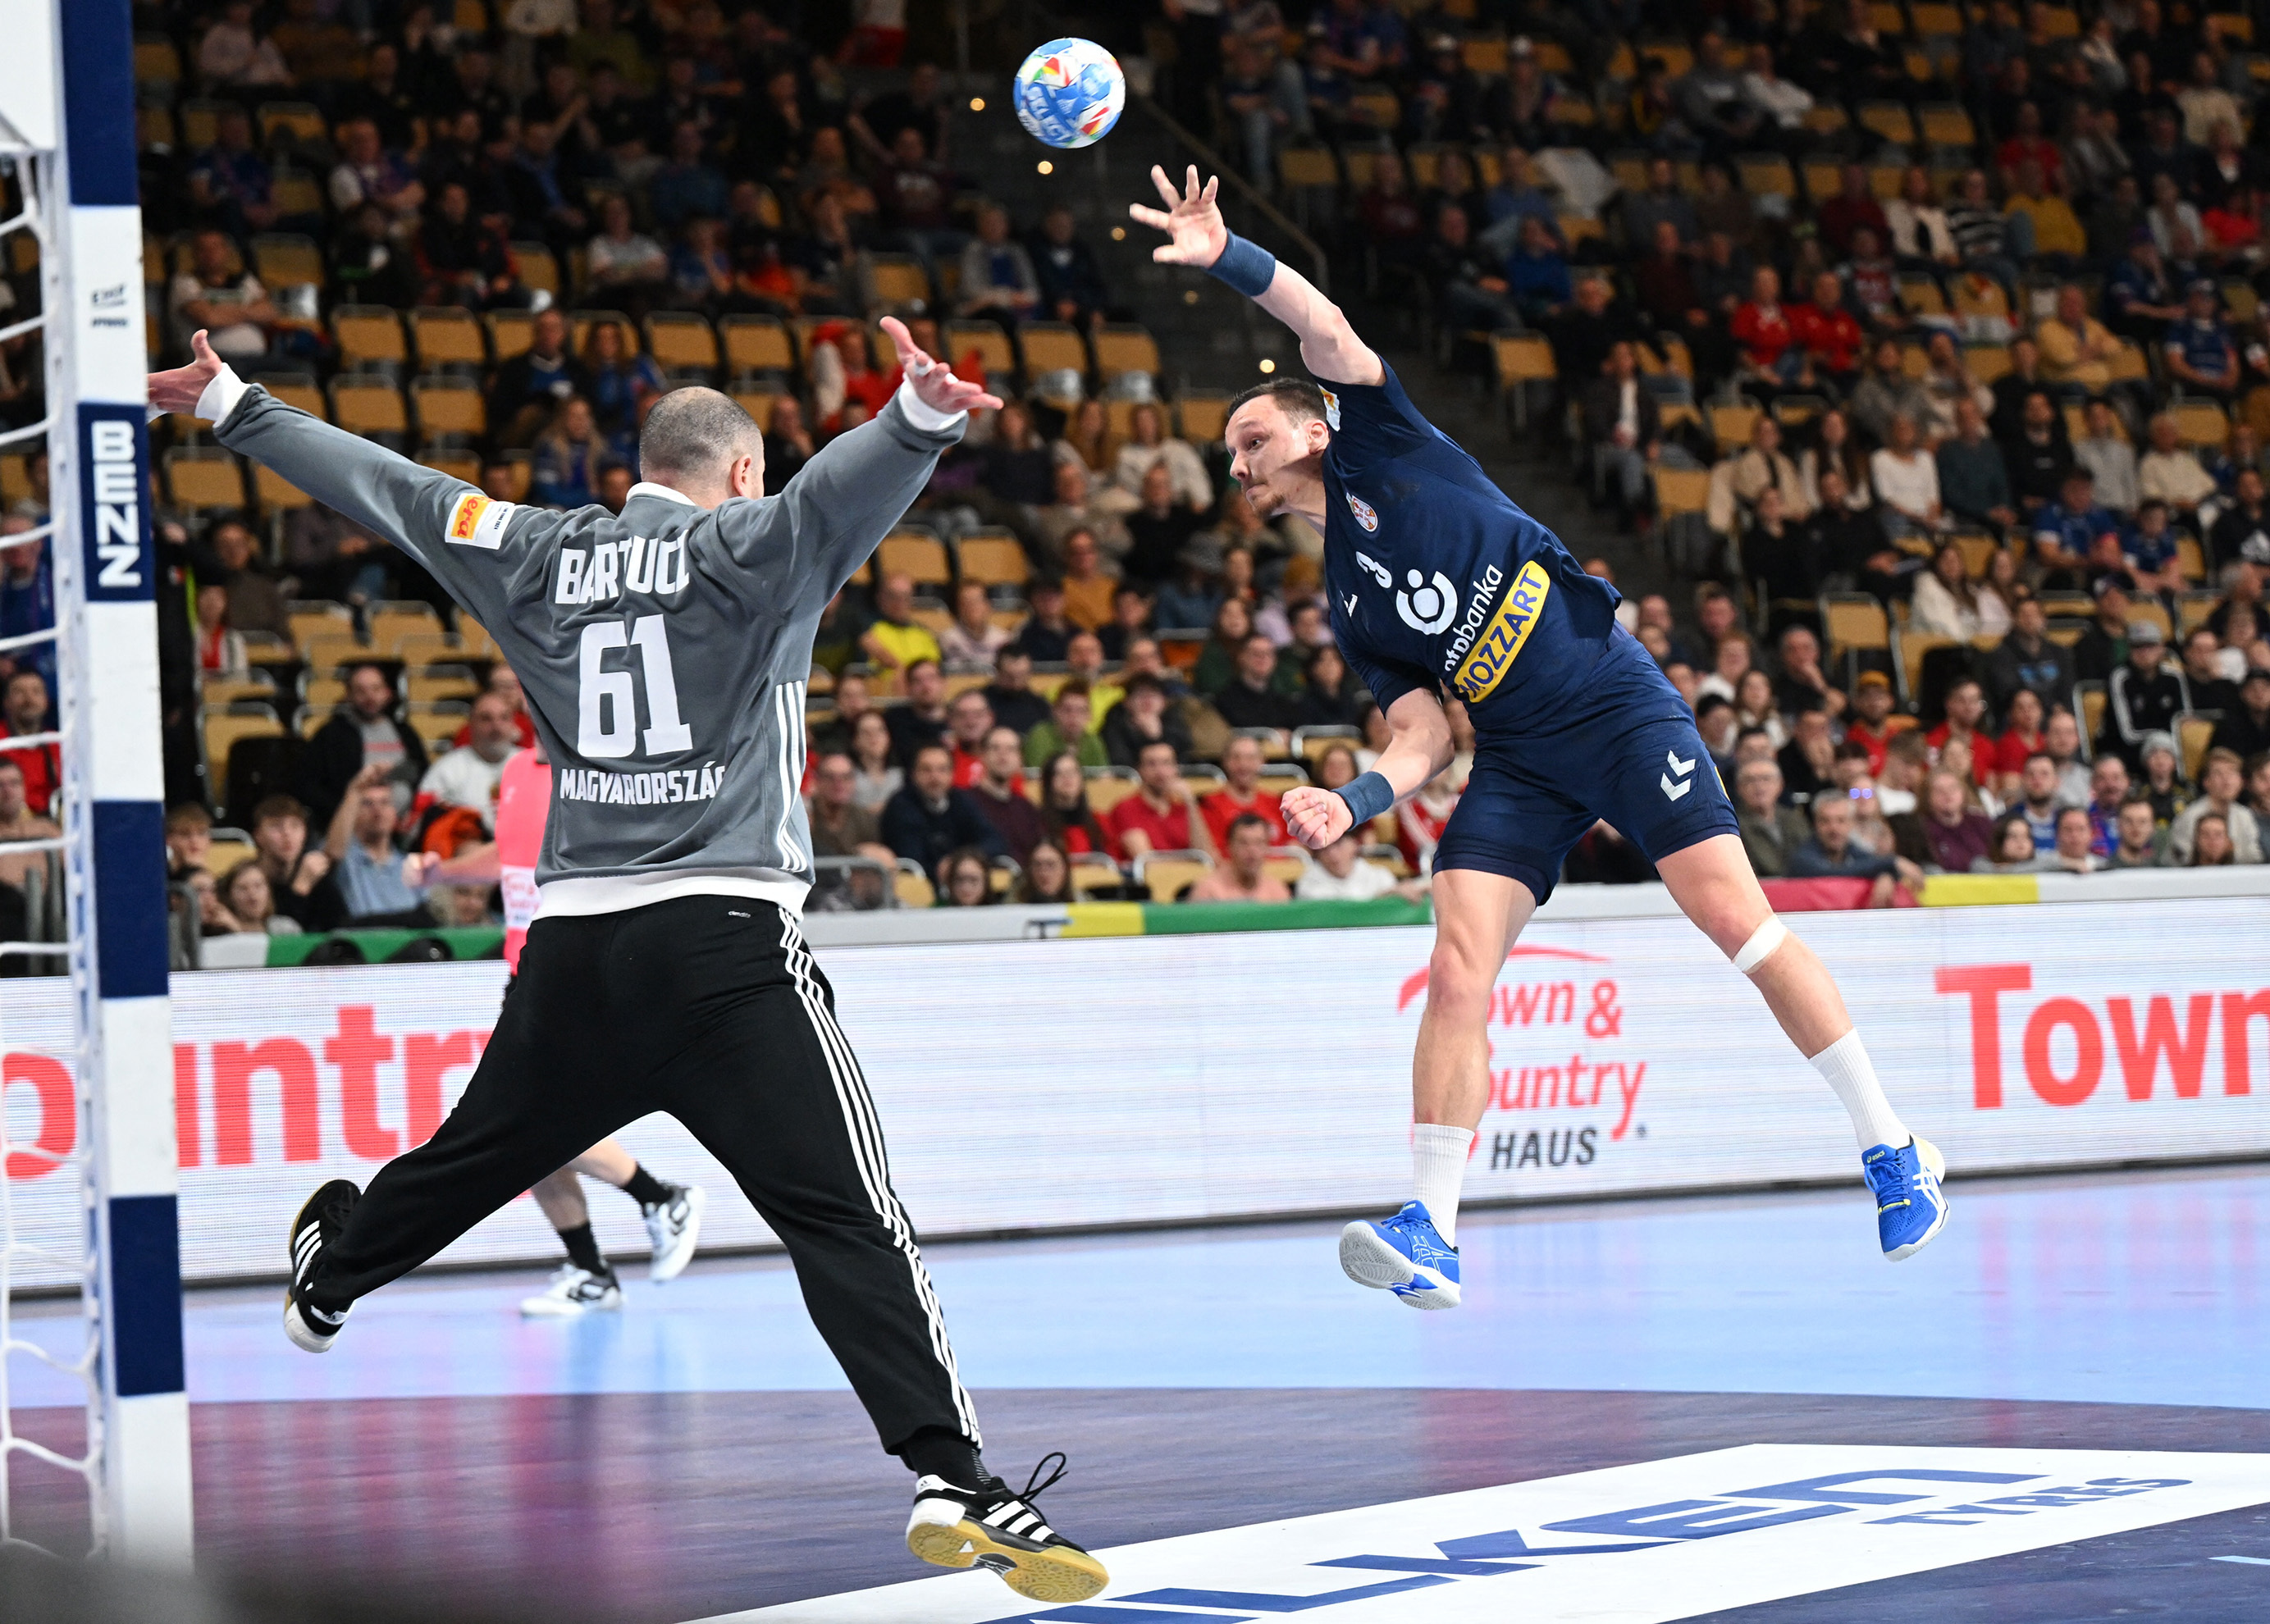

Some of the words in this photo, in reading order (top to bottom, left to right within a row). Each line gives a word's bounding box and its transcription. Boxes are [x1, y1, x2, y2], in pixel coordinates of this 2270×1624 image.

[91, 420, 142, 588] BENZ
[1355, 550, 1392, 589] 3
[1459, 568, 1542, 698] MOZZART
[578, 614, 693, 758] 61
[1584, 979, 1624, 1038] &
[1490, 1128, 1598, 1171] HAUS
[1860, 1477, 2194, 1526] TYRES
